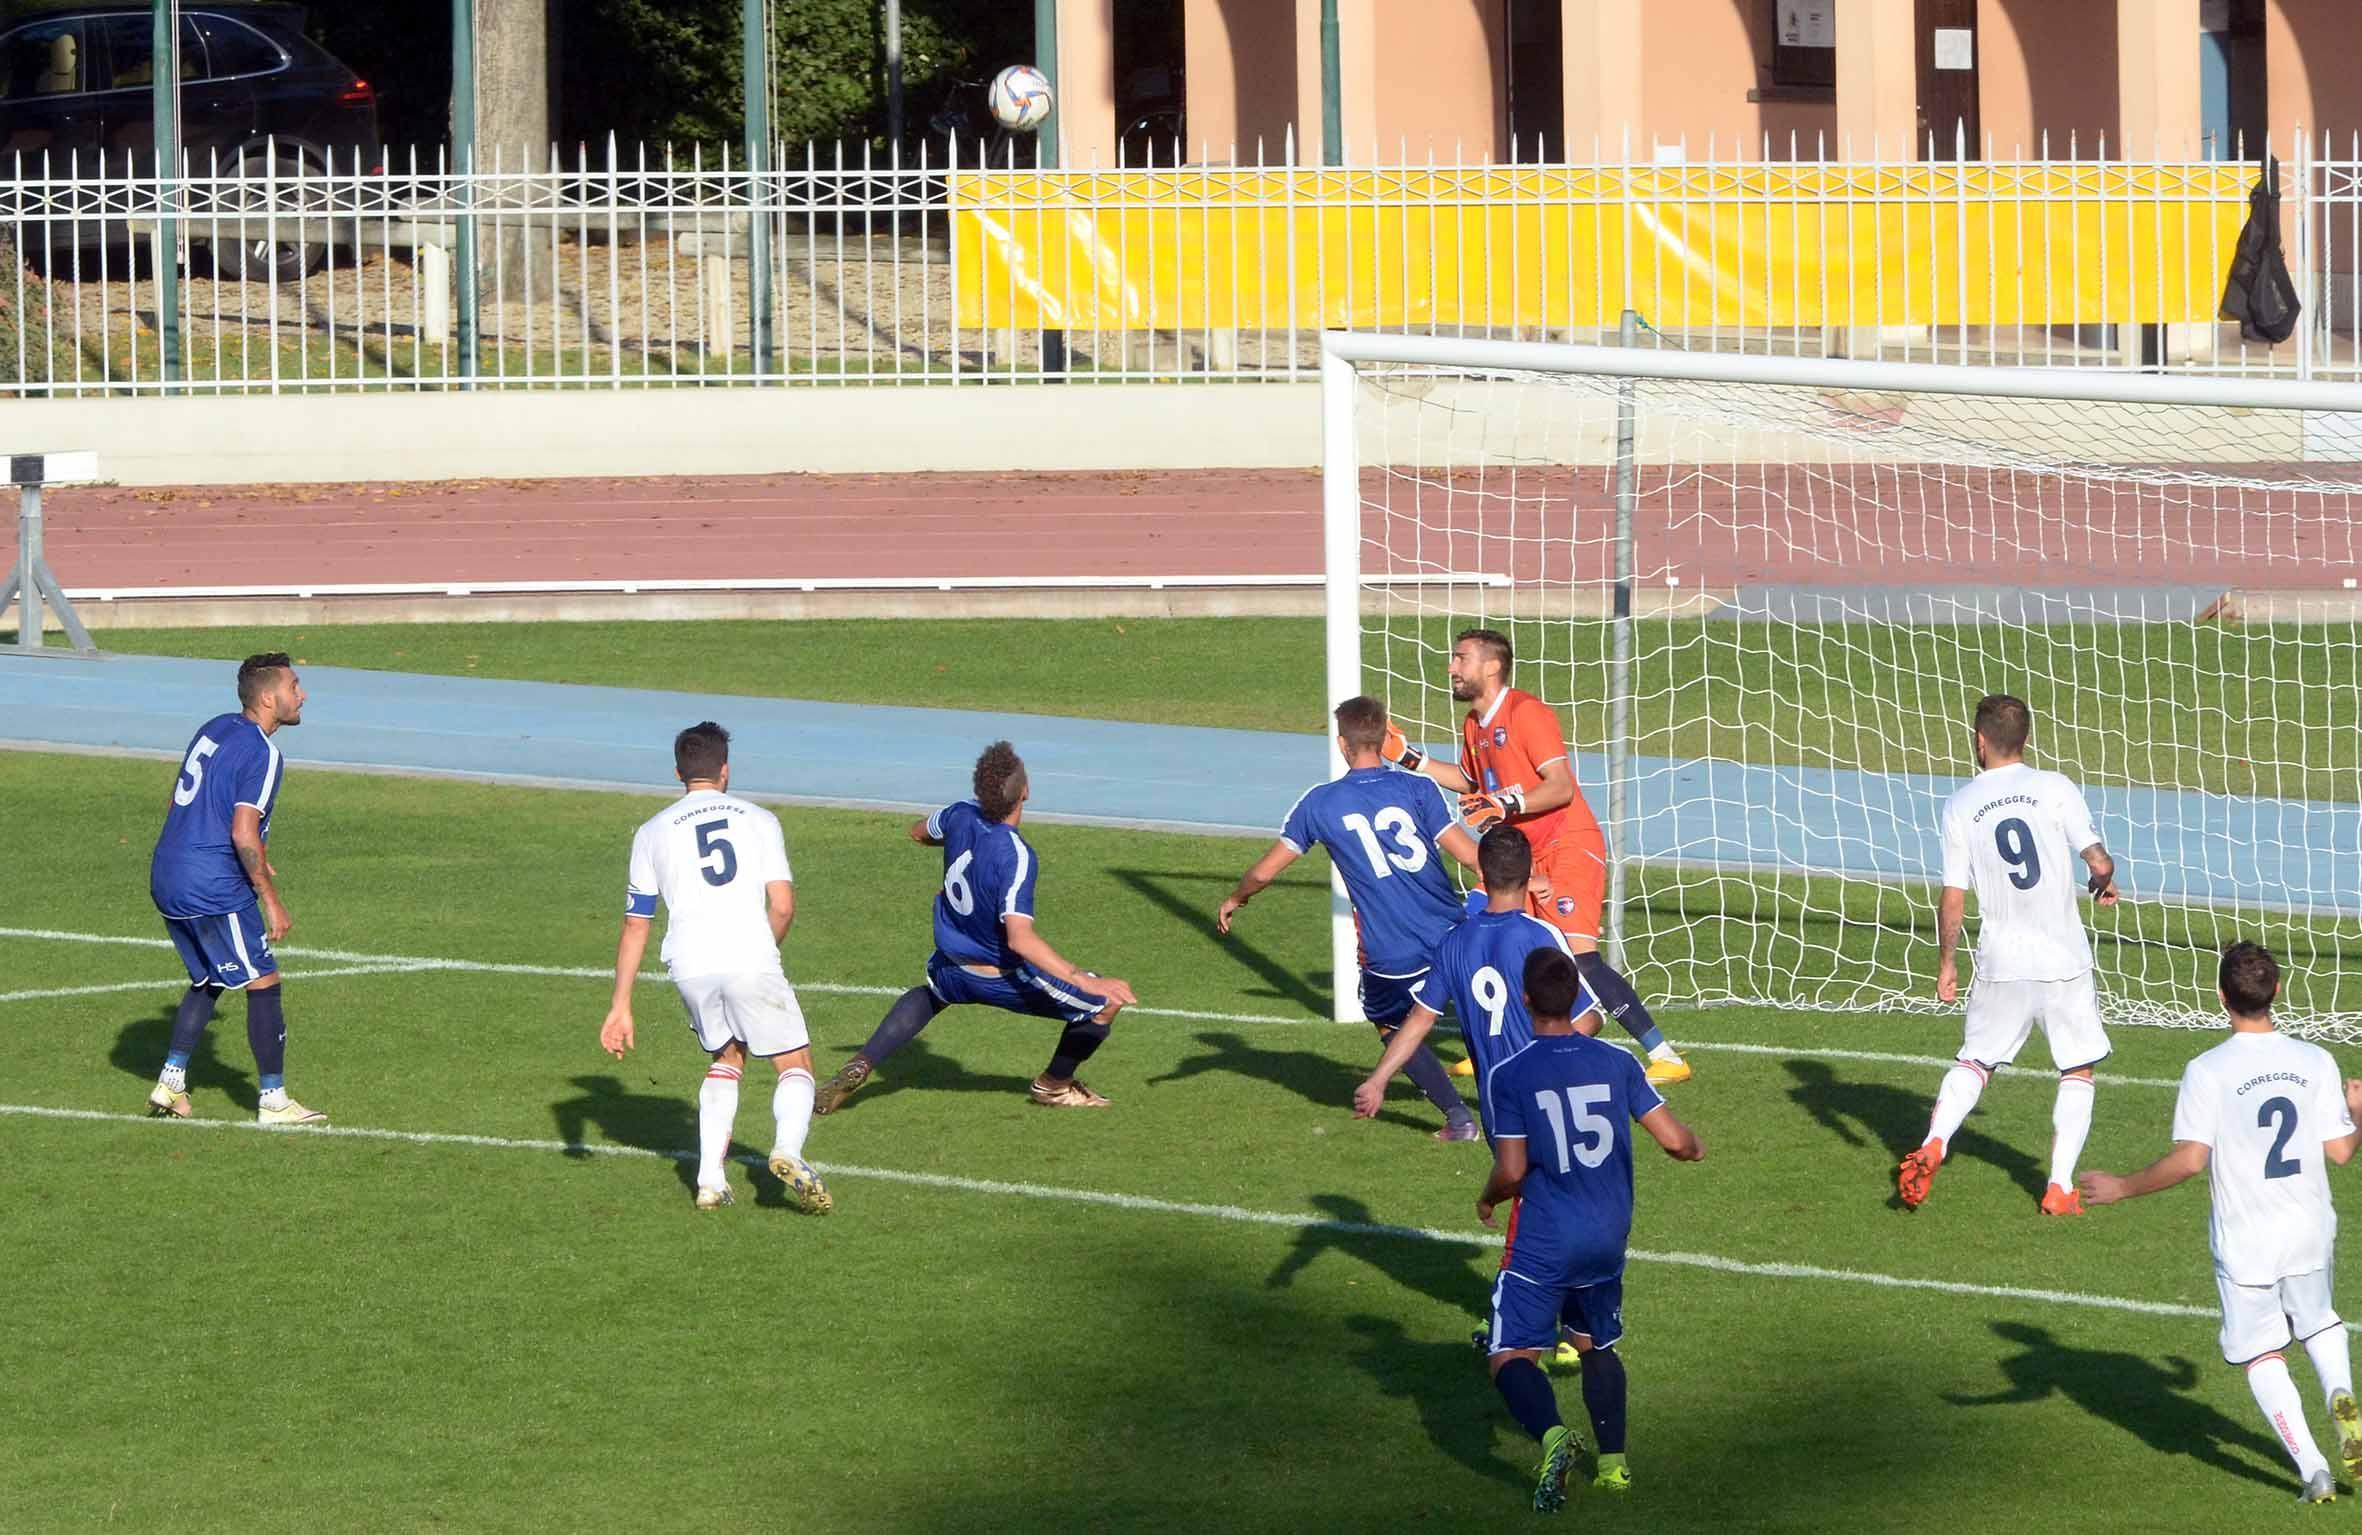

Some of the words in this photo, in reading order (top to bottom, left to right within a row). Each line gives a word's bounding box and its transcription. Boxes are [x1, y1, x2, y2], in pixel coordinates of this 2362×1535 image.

[174, 735, 219, 806] 5
[1342, 806, 1427, 878] 13
[1973, 795, 2039, 823] CORREGGESE
[695, 818, 737, 887] 5
[944, 849, 973, 916] 6
[1995, 817, 2041, 890] 9
[1471, 966, 1508, 1036] 9
[2236, 1072, 2309, 1096] CORREGGESE
[1535, 1084, 1614, 1174] 15
[2257, 1096, 2301, 1179] 2
